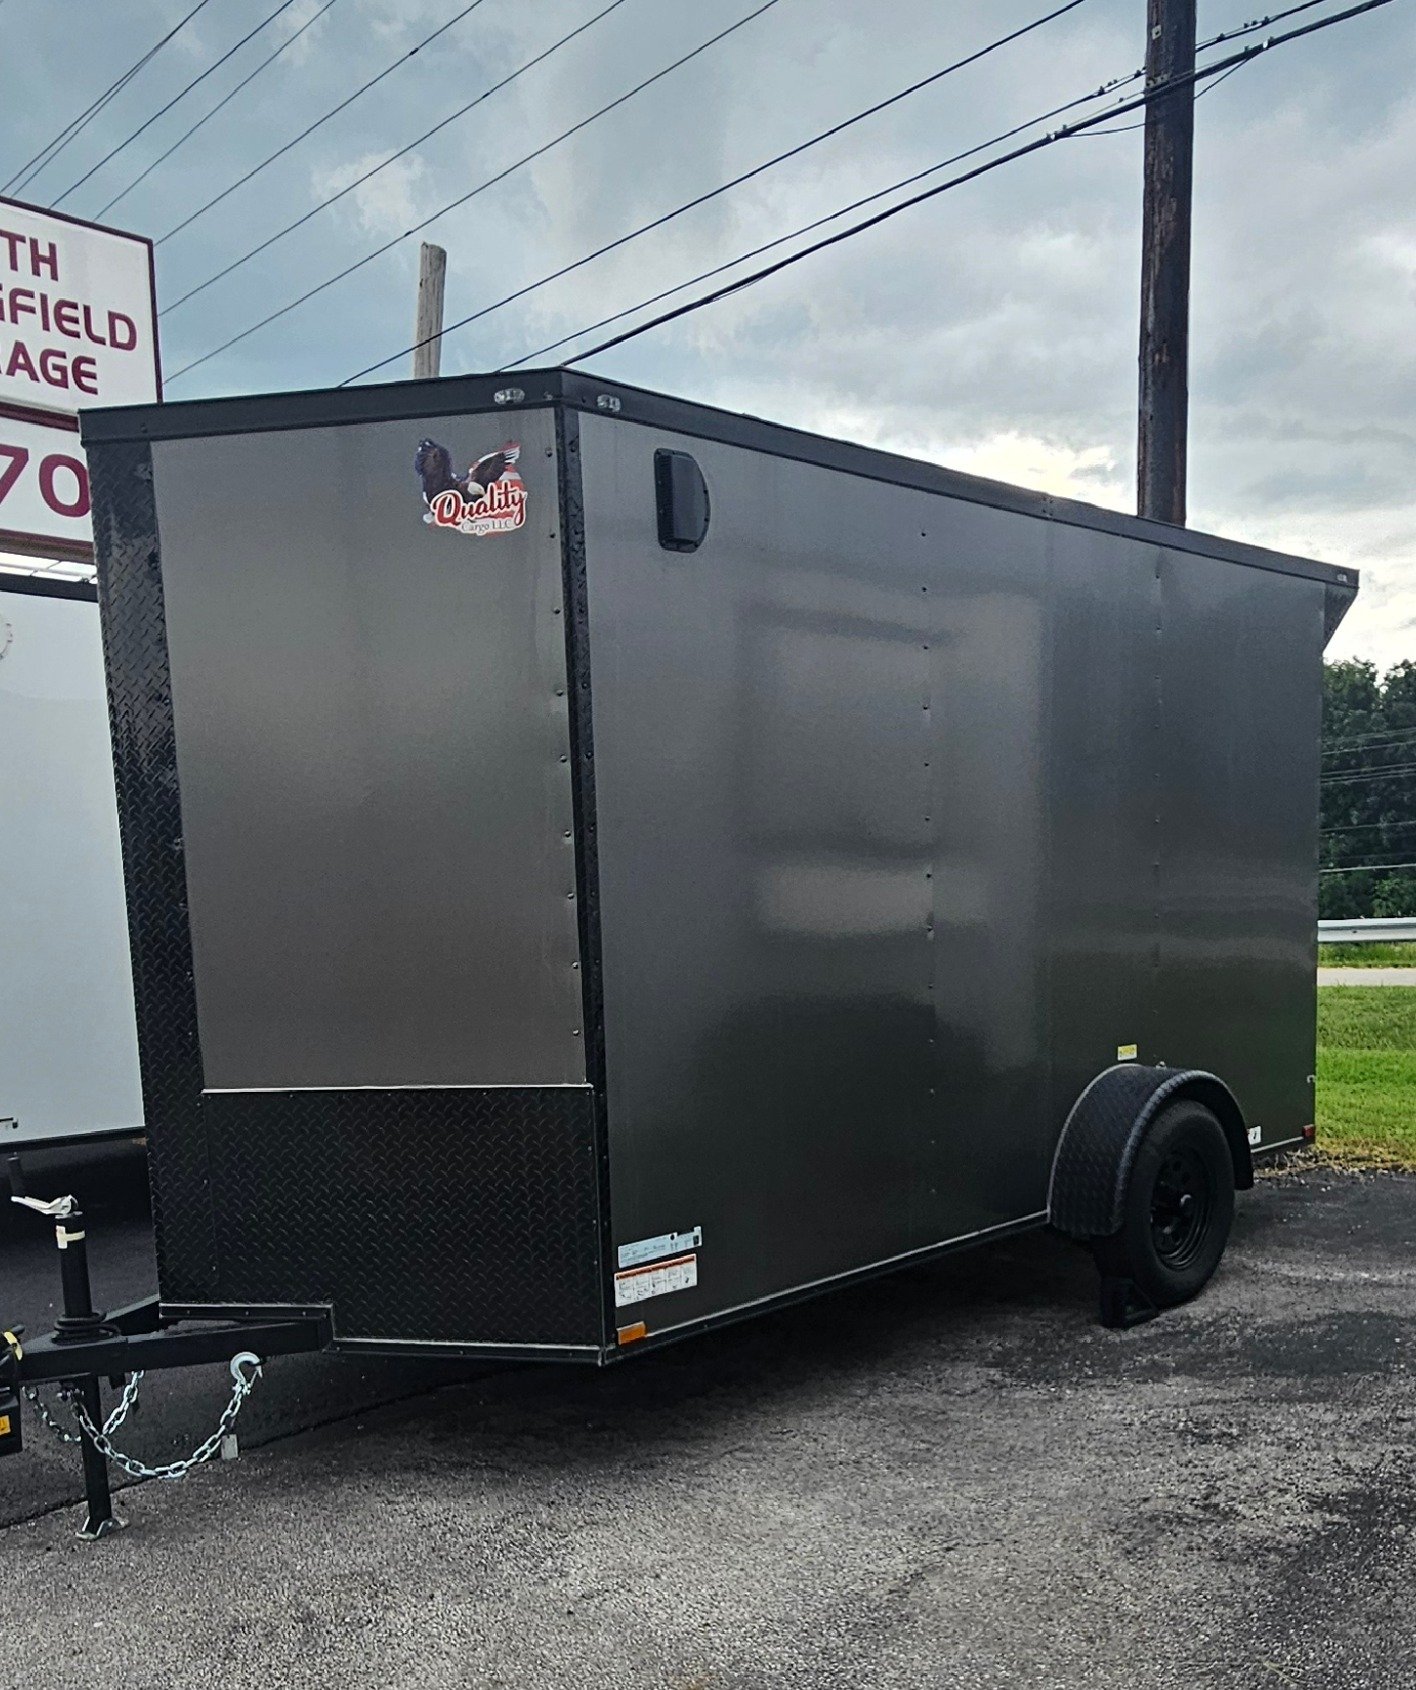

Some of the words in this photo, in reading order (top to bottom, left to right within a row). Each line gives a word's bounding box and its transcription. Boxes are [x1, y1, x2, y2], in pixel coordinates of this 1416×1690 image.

[0, 229, 58, 281] TH
[0, 283, 137, 351] FIELD
[0, 340, 98, 395] AGE
[432, 481, 526, 526] Quality
[461, 520, 489, 533] Cargo
[492, 519, 512, 529] LLC
